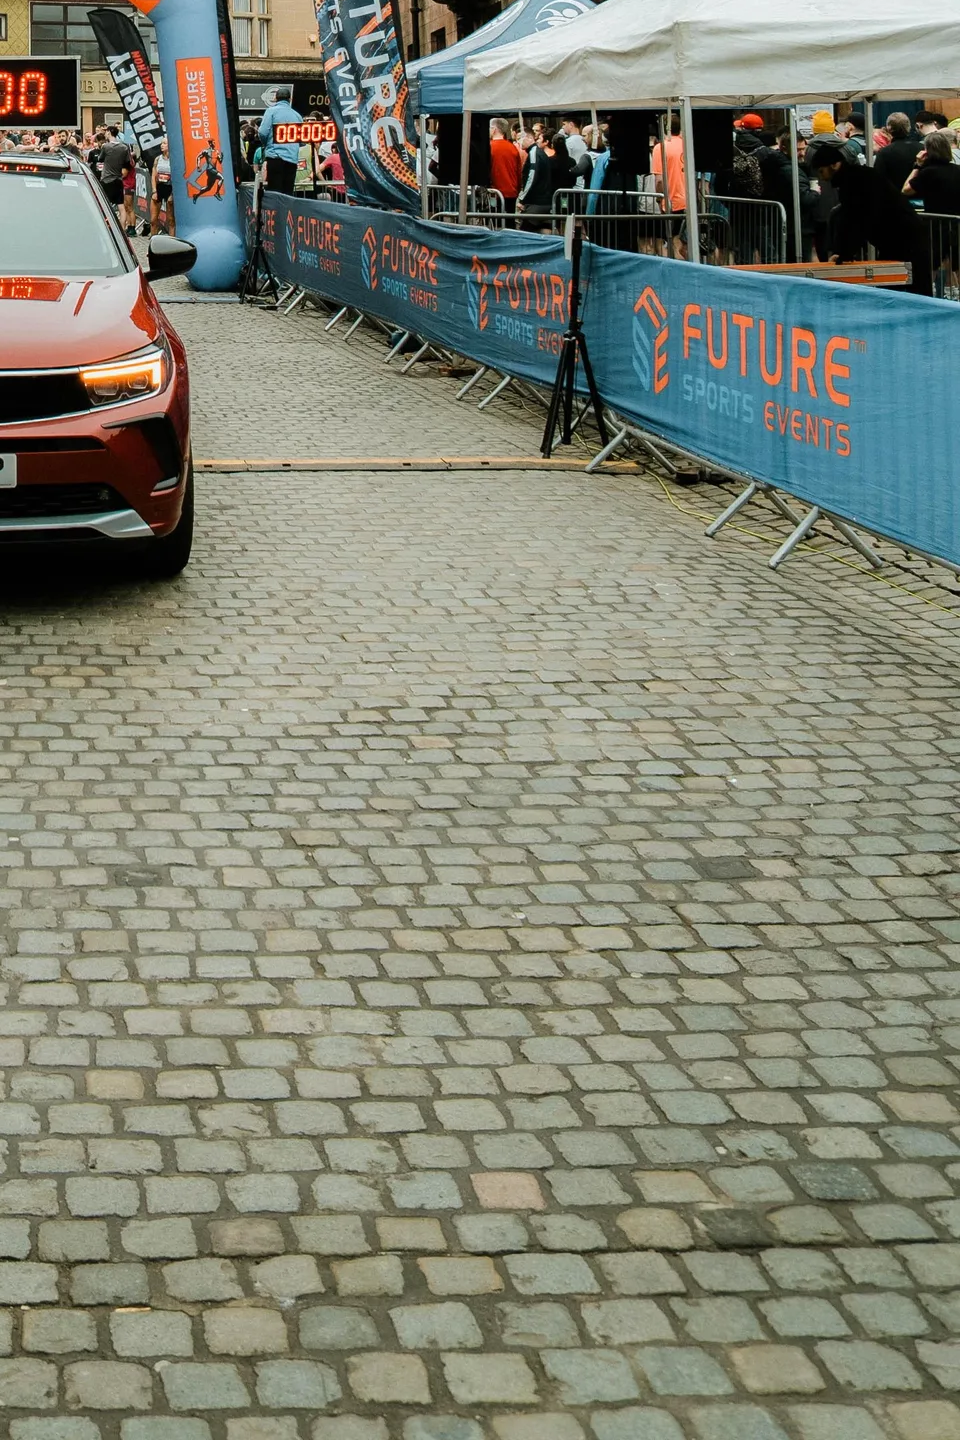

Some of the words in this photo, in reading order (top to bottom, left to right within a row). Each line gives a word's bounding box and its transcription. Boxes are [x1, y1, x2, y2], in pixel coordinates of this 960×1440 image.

[106, 51, 164, 151] PAISLEY
[186, 71, 204, 140] FUTURE
[199, 70, 208, 103] EVENTS
[334, 46, 365, 152] EVENTS
[200, 105, 211, 139] SPORTS
[297, 215, 341, 255] FUTURE
[298, 250, 318, 268] SPORTS
[319, 257, 341, 276] EVENTS
[382, 234, 439, 286] FUTURE
[382, 276, 408, 300] SPORTS
[410, 286, 438, 312] EVENTS
[495, 314, 533, 346] SPORTS
[683, 303, 851, 408] FUTURE
[683, 374, 755, 424] SPORTS
[763, 400, 851, 457] EVENTS
